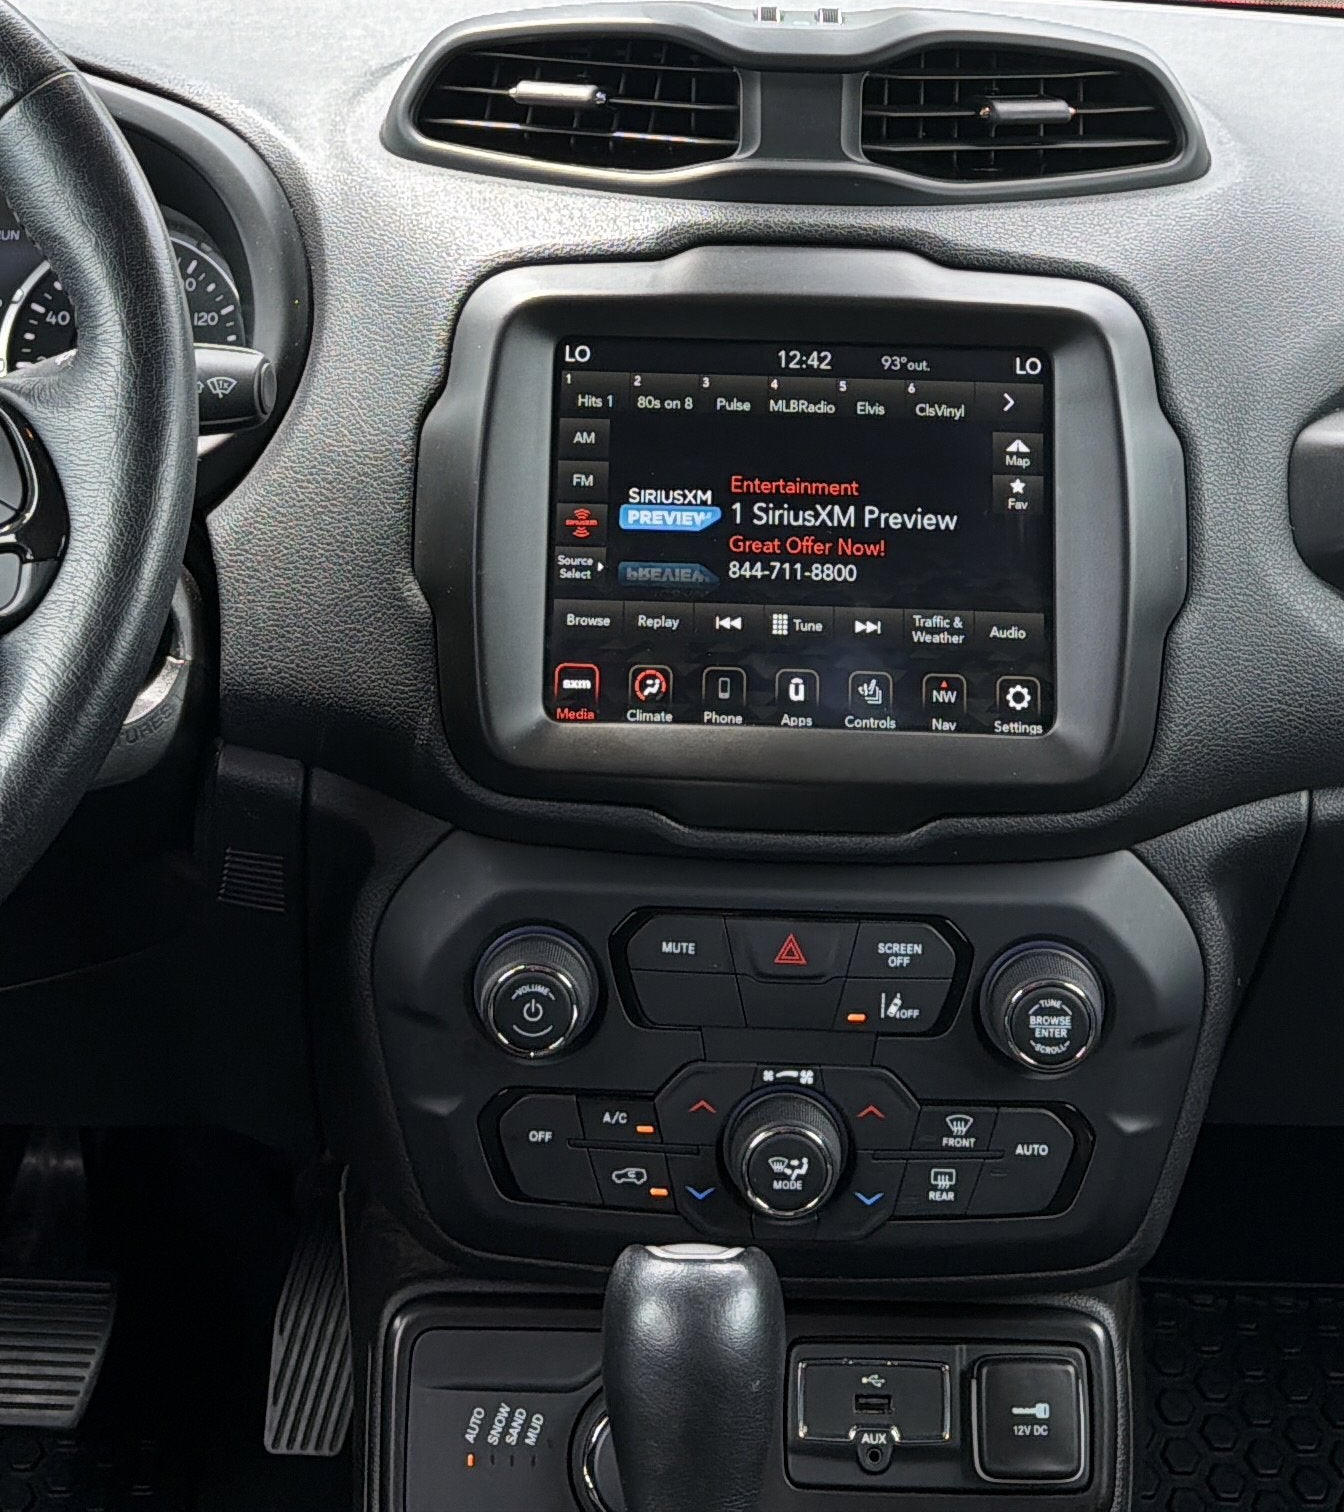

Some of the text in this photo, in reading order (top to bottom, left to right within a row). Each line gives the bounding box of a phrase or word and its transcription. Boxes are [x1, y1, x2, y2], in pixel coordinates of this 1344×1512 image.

[46, 311, 71, 326] 40
[194, 311, 219, 326] 120
[565, 345, 591, 363] LO
[778, 350, 833, 370] 12:42
[1015, 357, 1042, 376] LO
[565, 374, 572, 384] 1
[633, 375, 642, 386] 2
[702, 377, 710, 388] 3
[770, 379, 779, 390] 4
[839, 381, 847, 392] 5
[908, 382, 916, 394] 6
[577, 394, 613, 408] Hits 1
[637, 396, 693, 410] 80s on 8
[716, 398, 751, 411] Pulse
[769, 399, 836, 415] MLBRadio
[856, 402, 886, 416] Elvis
[915, 403, 965, 420] ClsVinyl
[573, 432, 596, 444] AM
[1006, 455, 1031, 469] Map
[573, 474, 594, 487] FM
[731, 475, 859, 496] Entertainment
[628, 487, 713, 505] SIRIUSXM
[1008, 497, 1029, 510] Fav
[627, 509, 712, 527] PREVIEW
[731, 502, 958, 530] 1 SiriusXM Preview
[729, 535, 886, 557] Great Offer Now!
[557, 554, 594, 566] Source
[559, 568, 592, 580] Select
[728, 561, 857, 582] 844-711-8800
[566, 613, 611, 627] Browse
[638, 615, 680, 630] Replay
[793, 619, 823, 633] Tune
[912, 615, 963, 629] Traffic &
[912, 631, 965, 644] Weather
[989, 626, 1027, 639] Audio
[932, 690, 957, 704] NW
[556, 708, 595, 720] Media
[626, 709, 673, 723] Climate
[704, 711, 743, 725] Phone
[781, 713, 812, 728] Apps
[844, 716, 896, 729] Controls
[932, 718, 957, 731] Nav
[994, 720, 1043, 736] Settings
[662, 941, 696, 955] MUTE
[878, 942, 923, 956] SCREEN
[888, 956, 911, 968] OFF
[516, 984, 551, 997] VOLUME
[1038, 998, 1063, 1010] TUNE
[899, 1008, 920, 1019] OFF
[1029, 1015, 1072, 1026] BROWSE
[1035, 1027, 1068, 1039] ENTER
[1032, 1040, 1068, 1055] SCROLL
[603, 1112, 628, 1125] A/C
[529, 1130, 553, 1142] OFF
[942, 1136, 976, 1149] FRONT
[1015, 1143, 1049, 1156] AUTO
[773, 1179, 803, 1191] MODE
[928, 1190, 955, 1202] REAR
[465, 1407, 485, 1444] AUTO
[487, 1402, 511, 1446] SNOW
[505, 1408, 527, 1446] SAND
[524, 1413, 544, 1446] MUD
[1013, 1424, 1049, 1436] 12V DC
[861, 1432, 887, 1445] AUX
